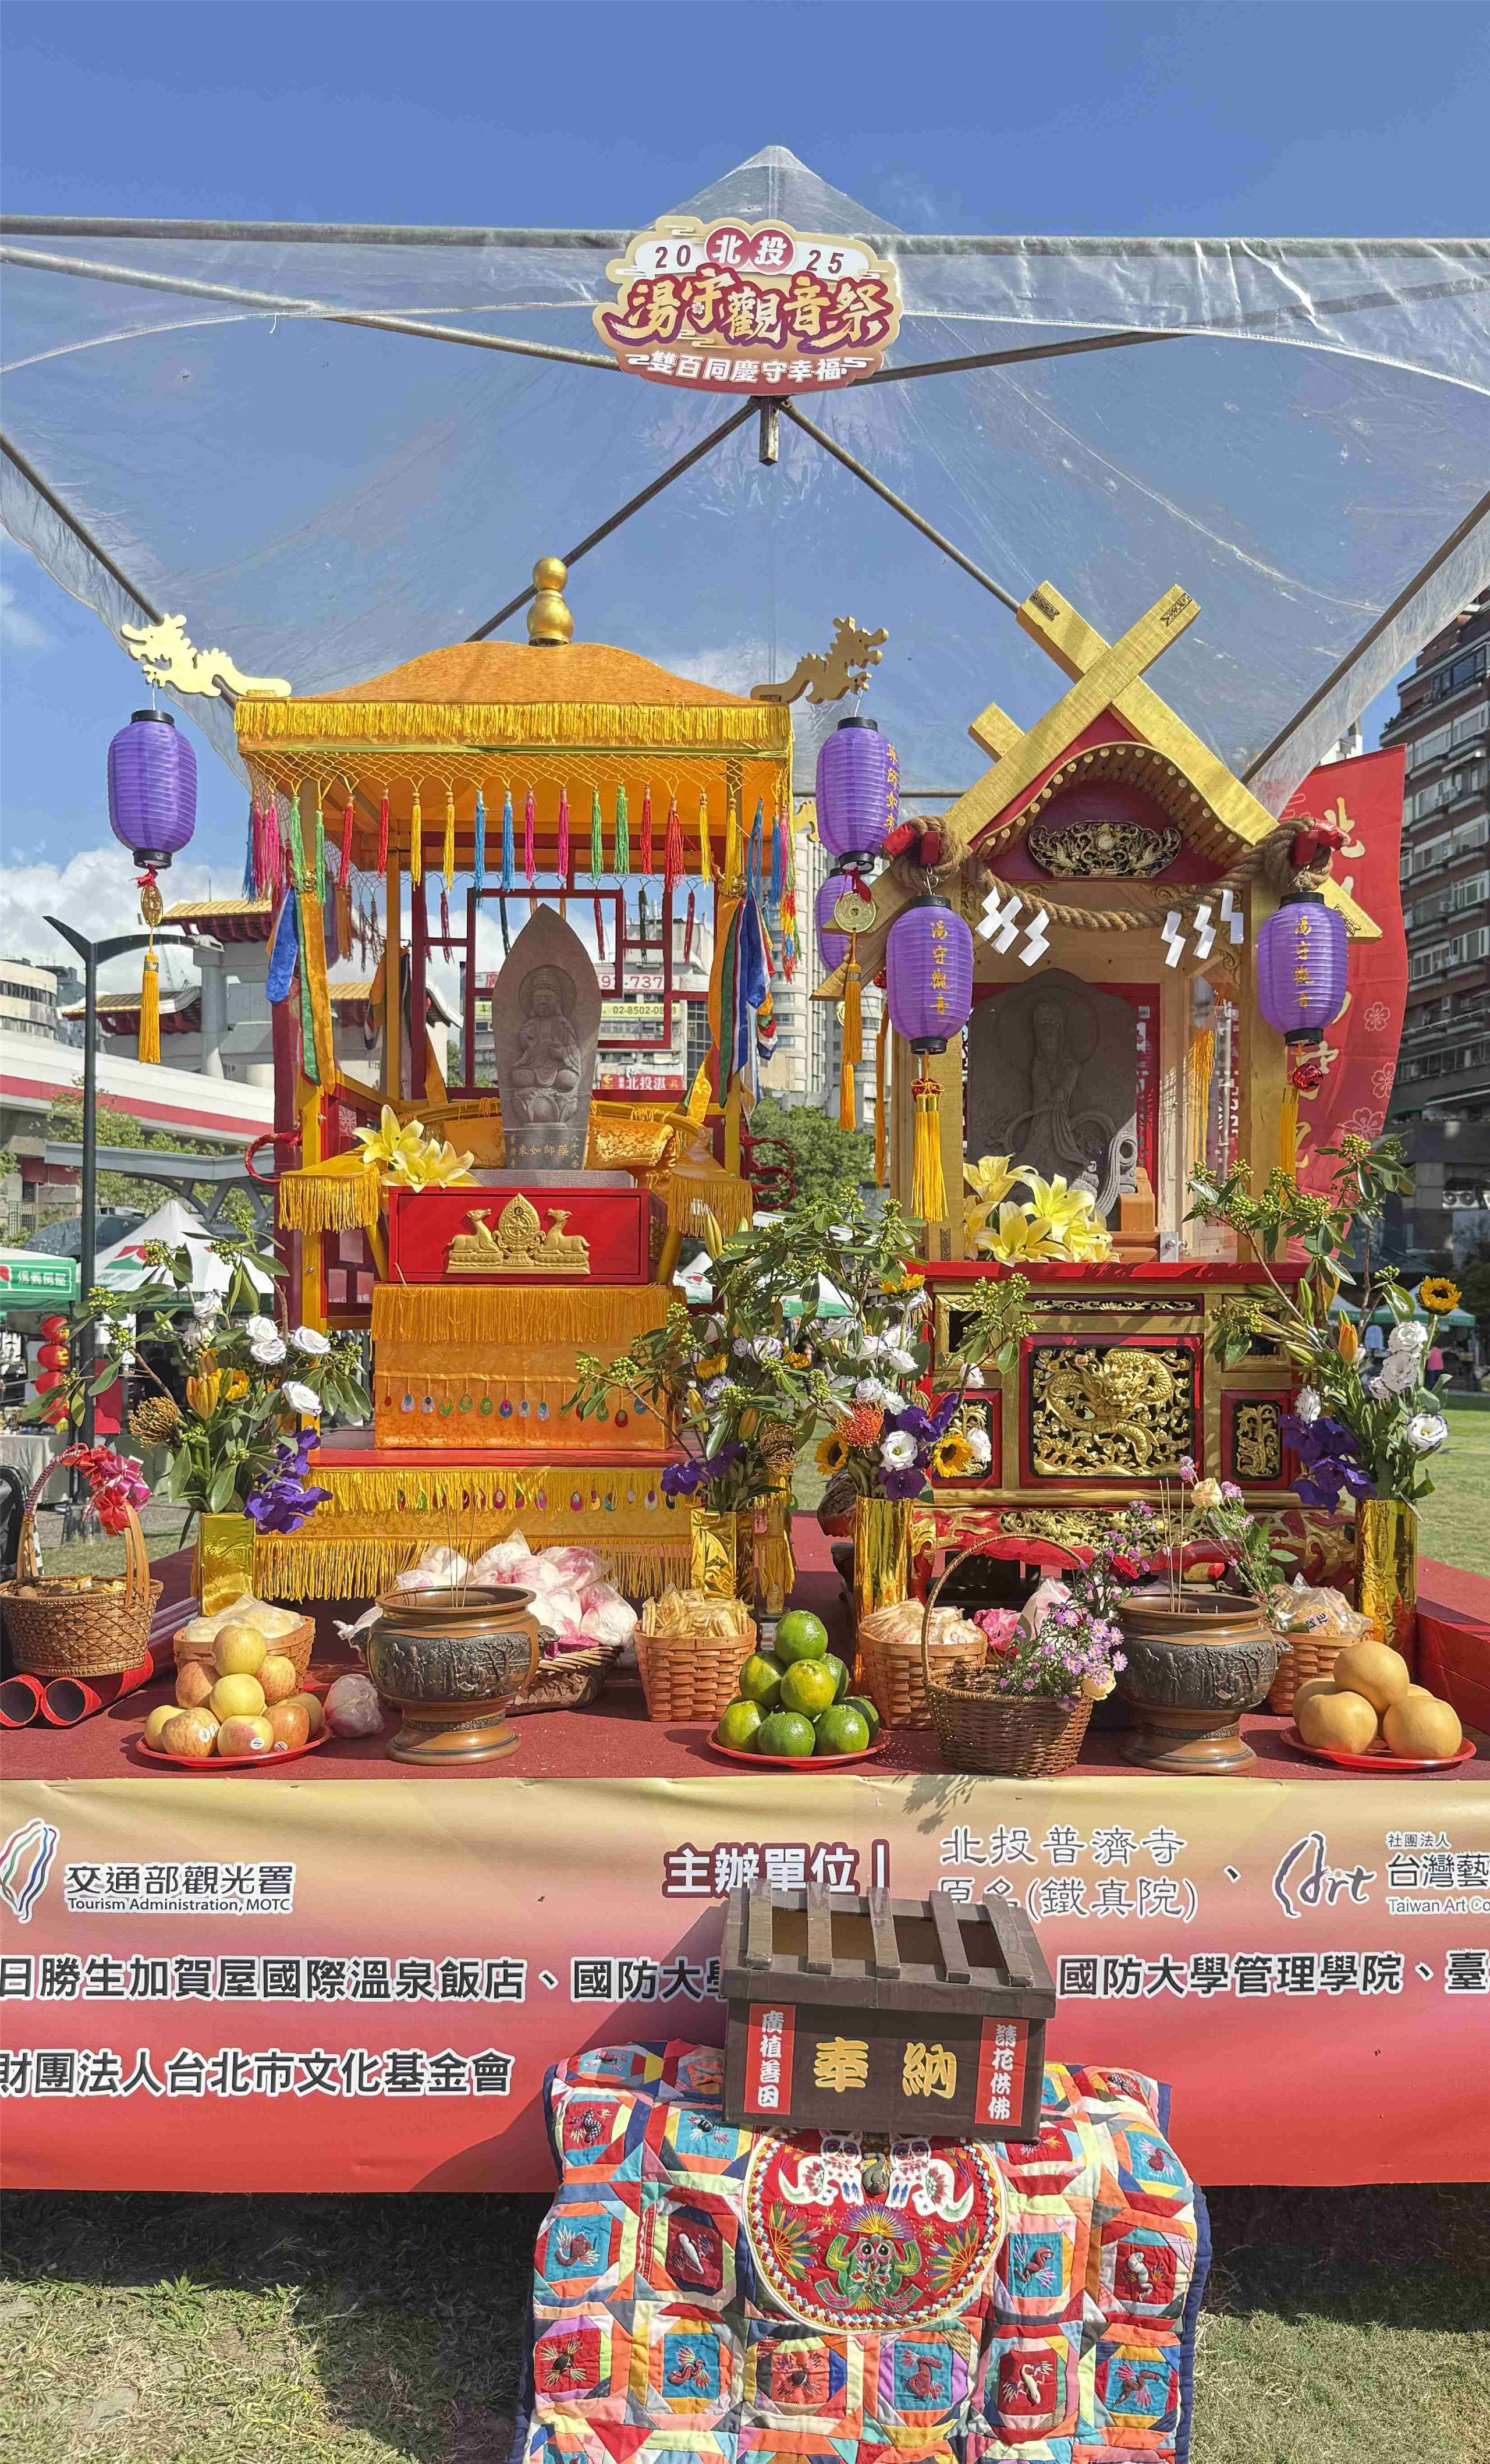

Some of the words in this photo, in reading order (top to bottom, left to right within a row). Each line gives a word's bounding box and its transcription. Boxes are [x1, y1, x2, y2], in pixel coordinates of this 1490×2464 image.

[655, 244, 691, 269] 20
[711, 234, 788, 266] 北投
[806, 249, 845, 274] 25
[609, 267, 891, 349] 湯守觀音祭
[647, 349, 847, 382] 雙百同慶守幸福
[930, 919, 950, 1015] 湯守觀音
[942, 1826, 1186, 1865] 北投普濟寺
[1388, 1833, 1450, 1848] 社團法人
[66, 1865, 293, 1895] 交通部觀光署
[68, 1898, 126, 1911] Tourism
[130, 1898, 243, 1912] Administration,
[246, 1898, 290, 1911] MOTC
[1388, 1898, 1440, 1912] Taiwan
[1443, 1898, 1466, 1912] Art
[0, 2050, 511, 2096] 財團法人台北市文化基金會
[757, 2009, 785, 2108] 廣植善因
[813, 2036, 958, 2100] 奉納
[988, 2023, 1017, 2121] 請花供佛
